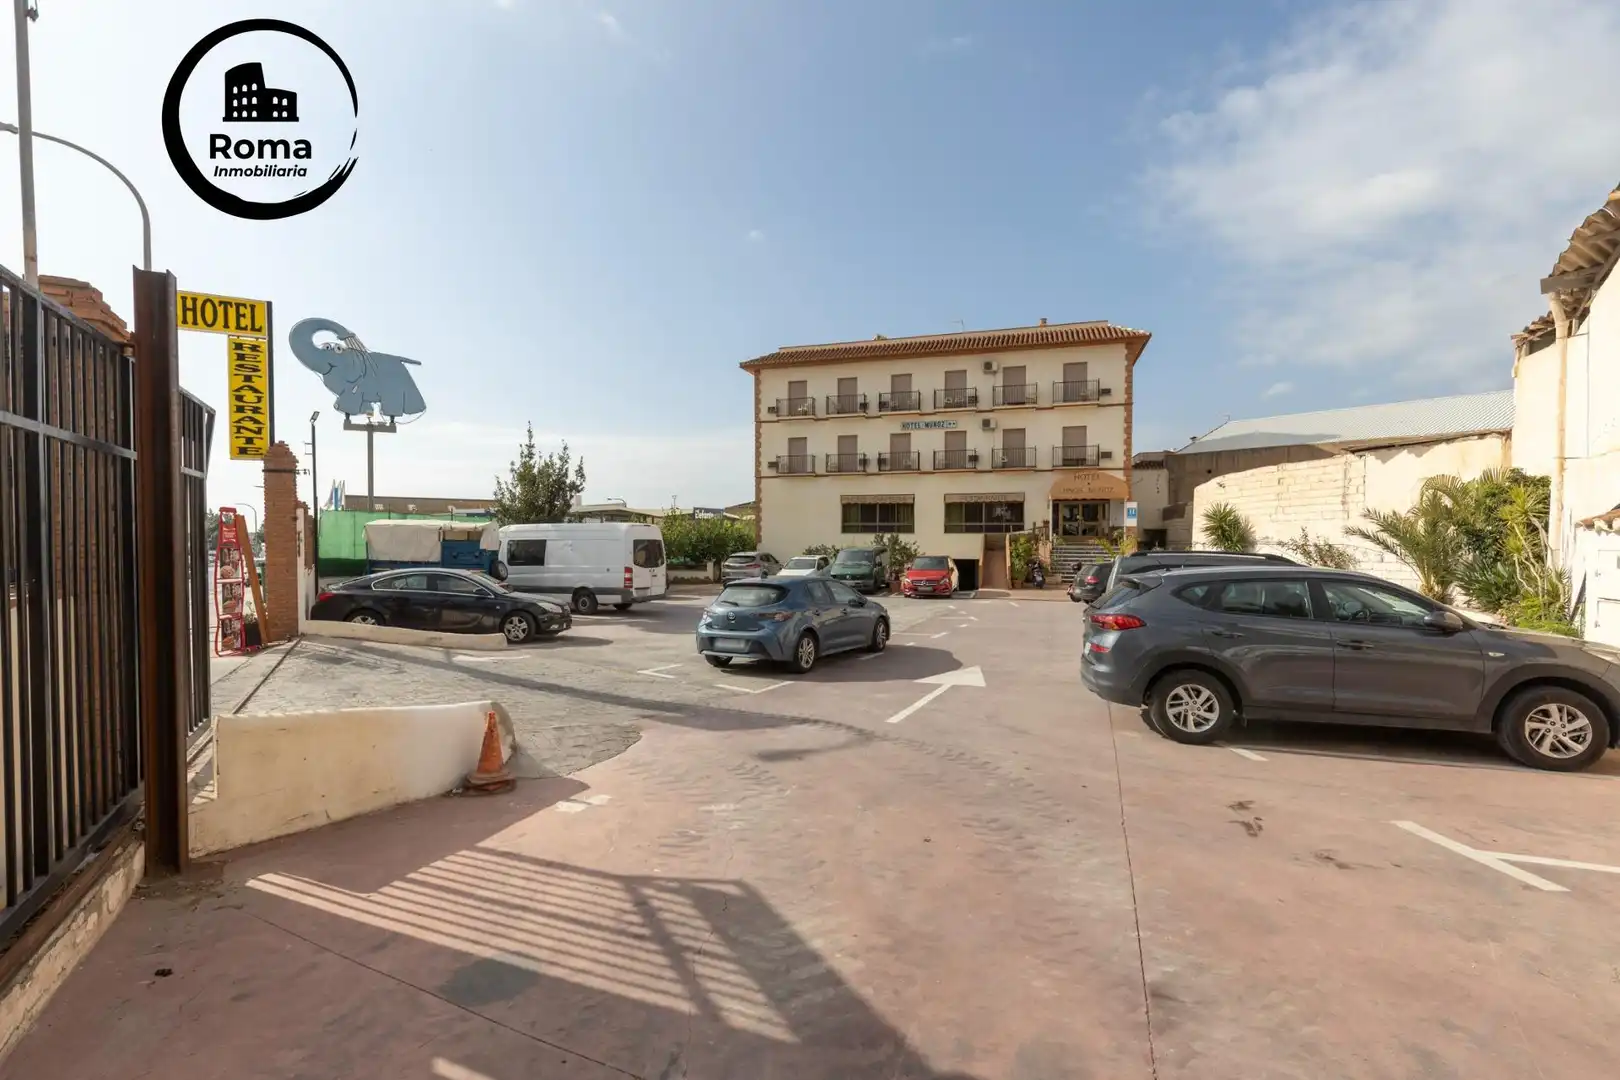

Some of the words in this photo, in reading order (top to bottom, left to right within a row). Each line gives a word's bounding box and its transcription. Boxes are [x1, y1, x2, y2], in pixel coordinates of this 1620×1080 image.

[180, 296, 262, 332] HOTEL
[232, 341, 265, 456] RESTAURANTE
[1074, 473, 1100, 481] HOTEL
